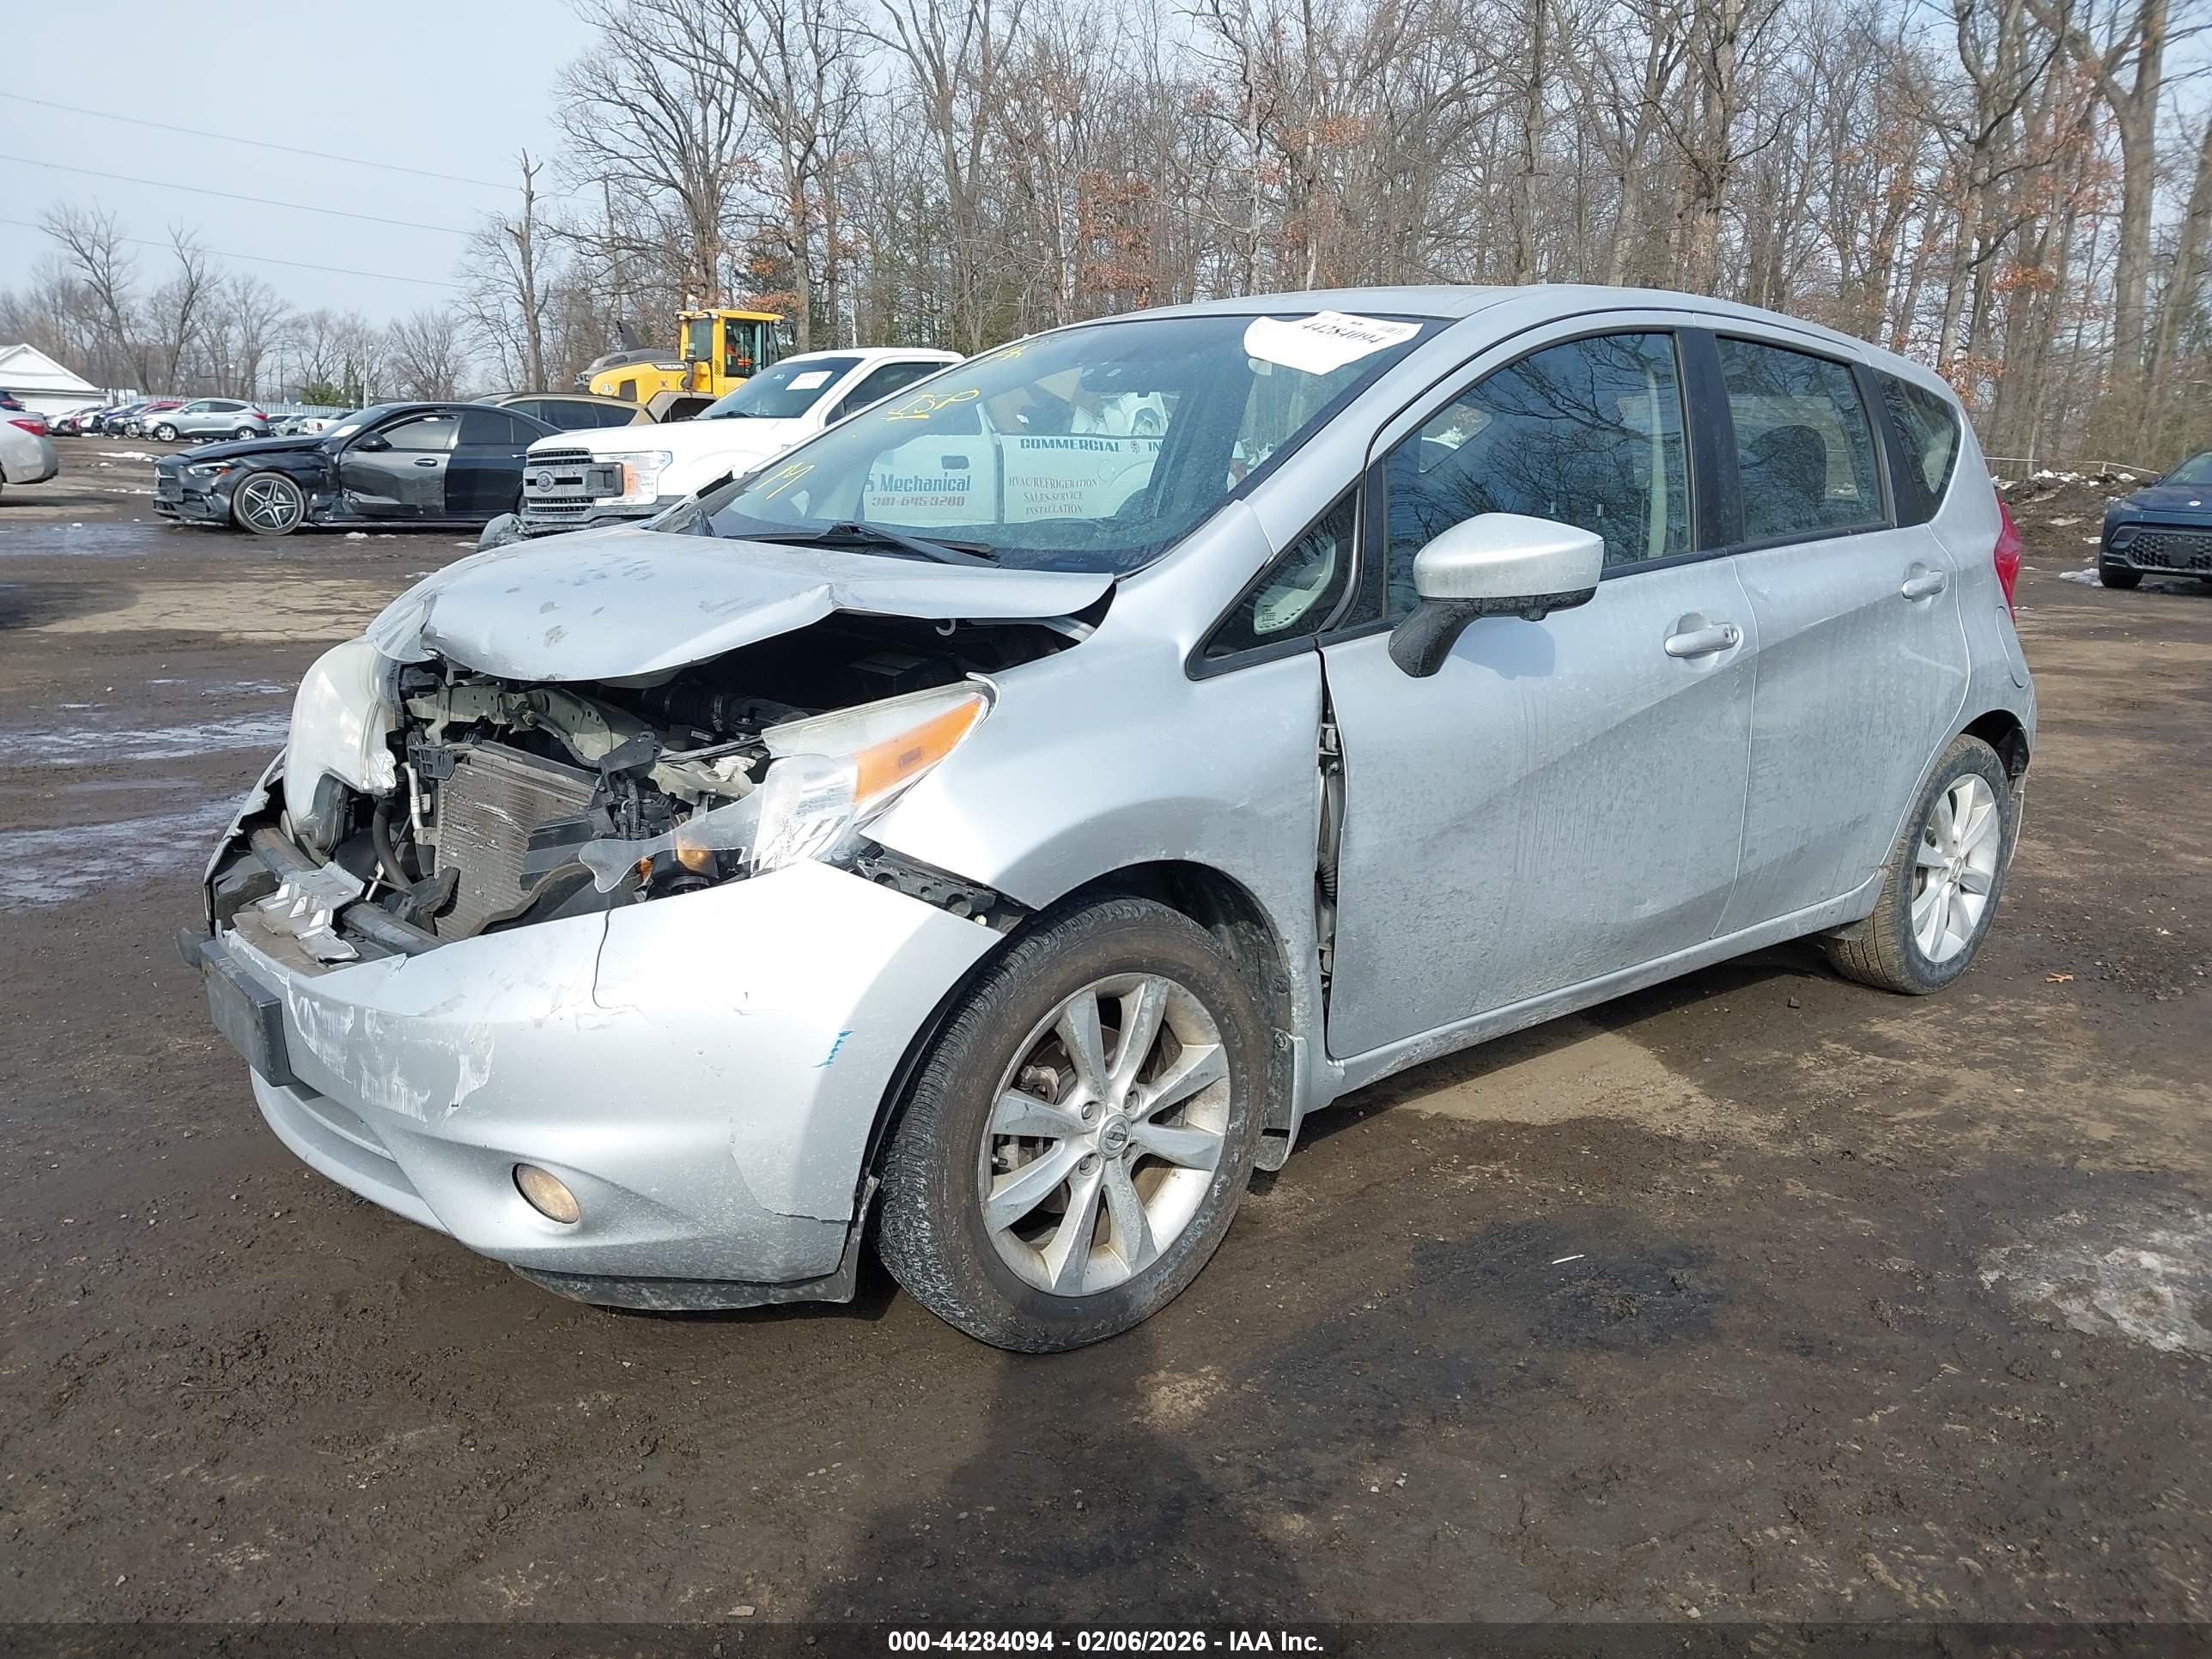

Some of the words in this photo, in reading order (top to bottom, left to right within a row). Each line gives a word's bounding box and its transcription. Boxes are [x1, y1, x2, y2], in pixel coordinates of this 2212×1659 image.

[1020, 439, 1121, 453] COMMERCIAL
[880, 471, 971, 492] Mechanical
[1025, 503, 1083, 515] INSTALLATION
